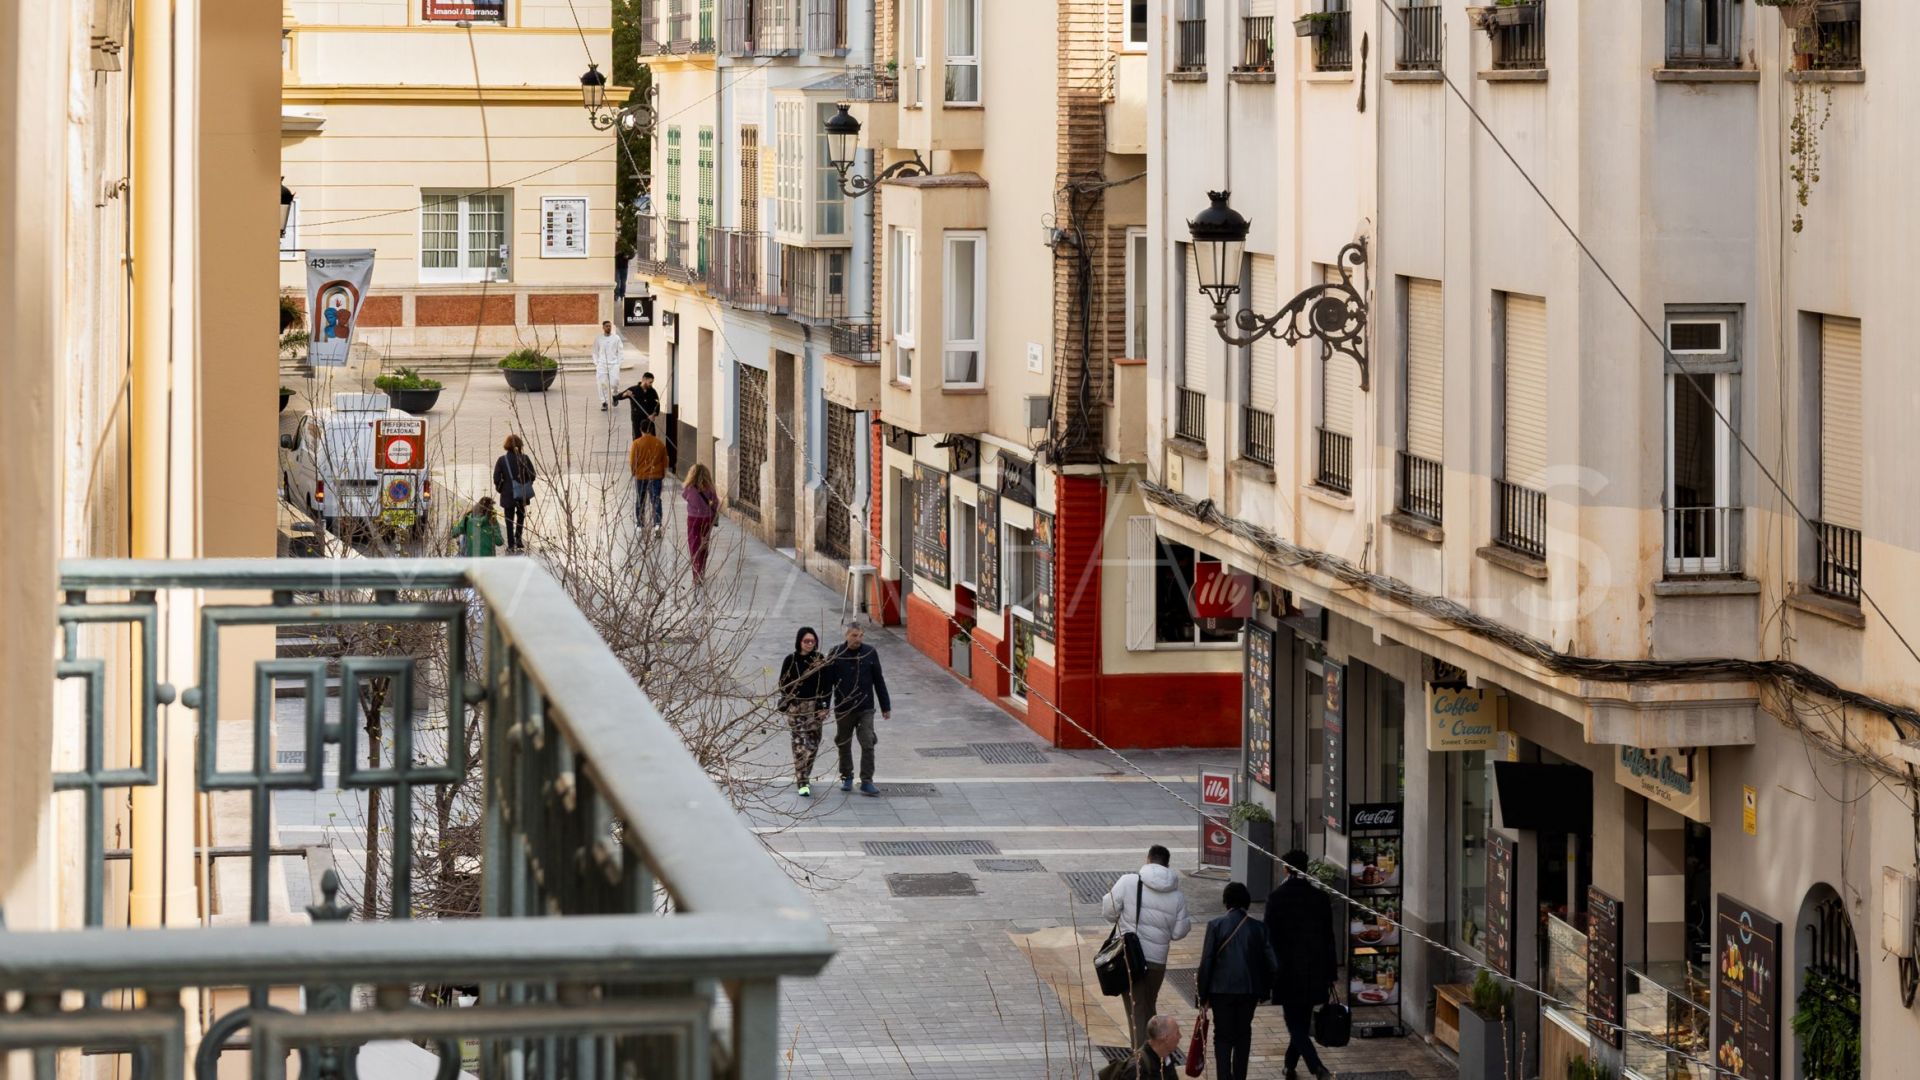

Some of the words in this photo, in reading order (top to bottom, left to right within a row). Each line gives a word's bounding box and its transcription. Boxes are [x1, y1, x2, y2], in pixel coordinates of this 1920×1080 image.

[465, 8, 499, 16] Barranco
[311, 258, 325, 269] 43
[1199, 571, 1248, 613] illy
[1433, 695, 1479, 716] Coffee
[1451, 719, 1492, 737] Cream
[1441, 738, 1461, 746] Sweet
[1205, 780, 1228, 802] illy
